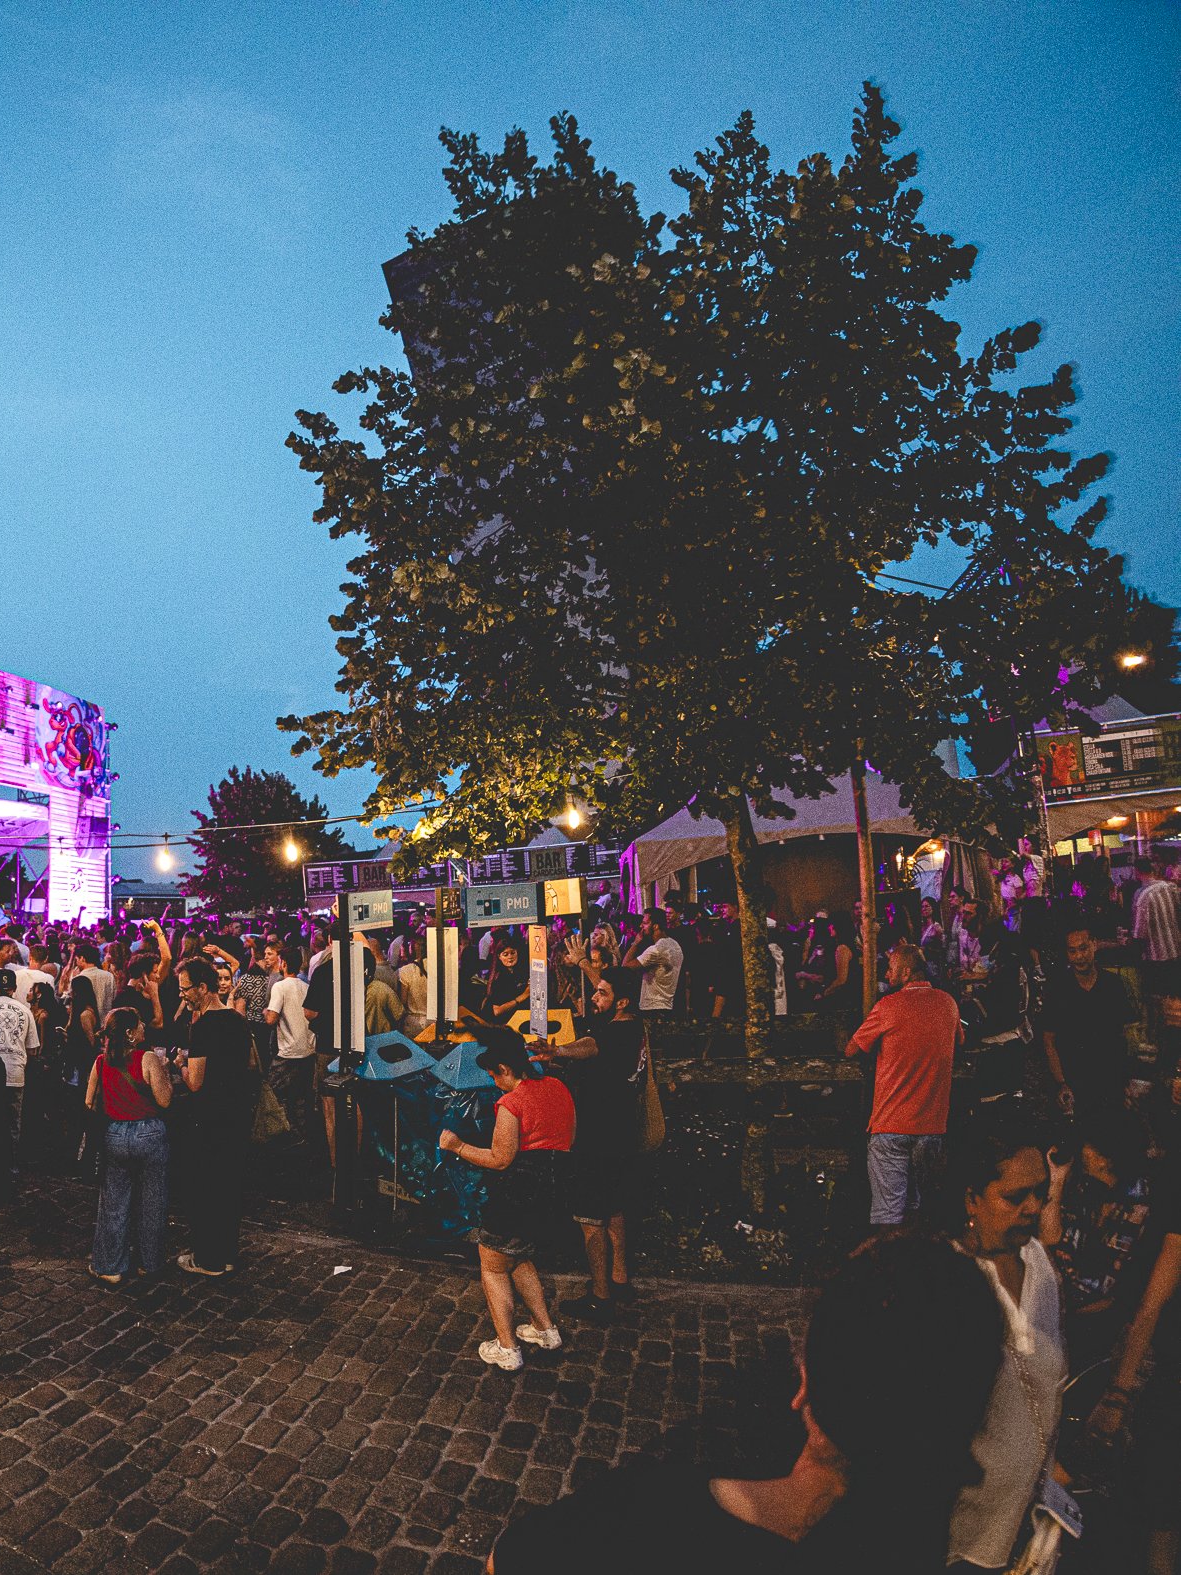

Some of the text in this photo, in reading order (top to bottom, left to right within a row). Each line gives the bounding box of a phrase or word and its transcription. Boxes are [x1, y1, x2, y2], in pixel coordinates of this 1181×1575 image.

[536, 851, 561, 870] BAR
[363, 866, 387, 882] BAR
[372, 902, 388, 915] PMD
[506, 896, 530, 911] PMD
